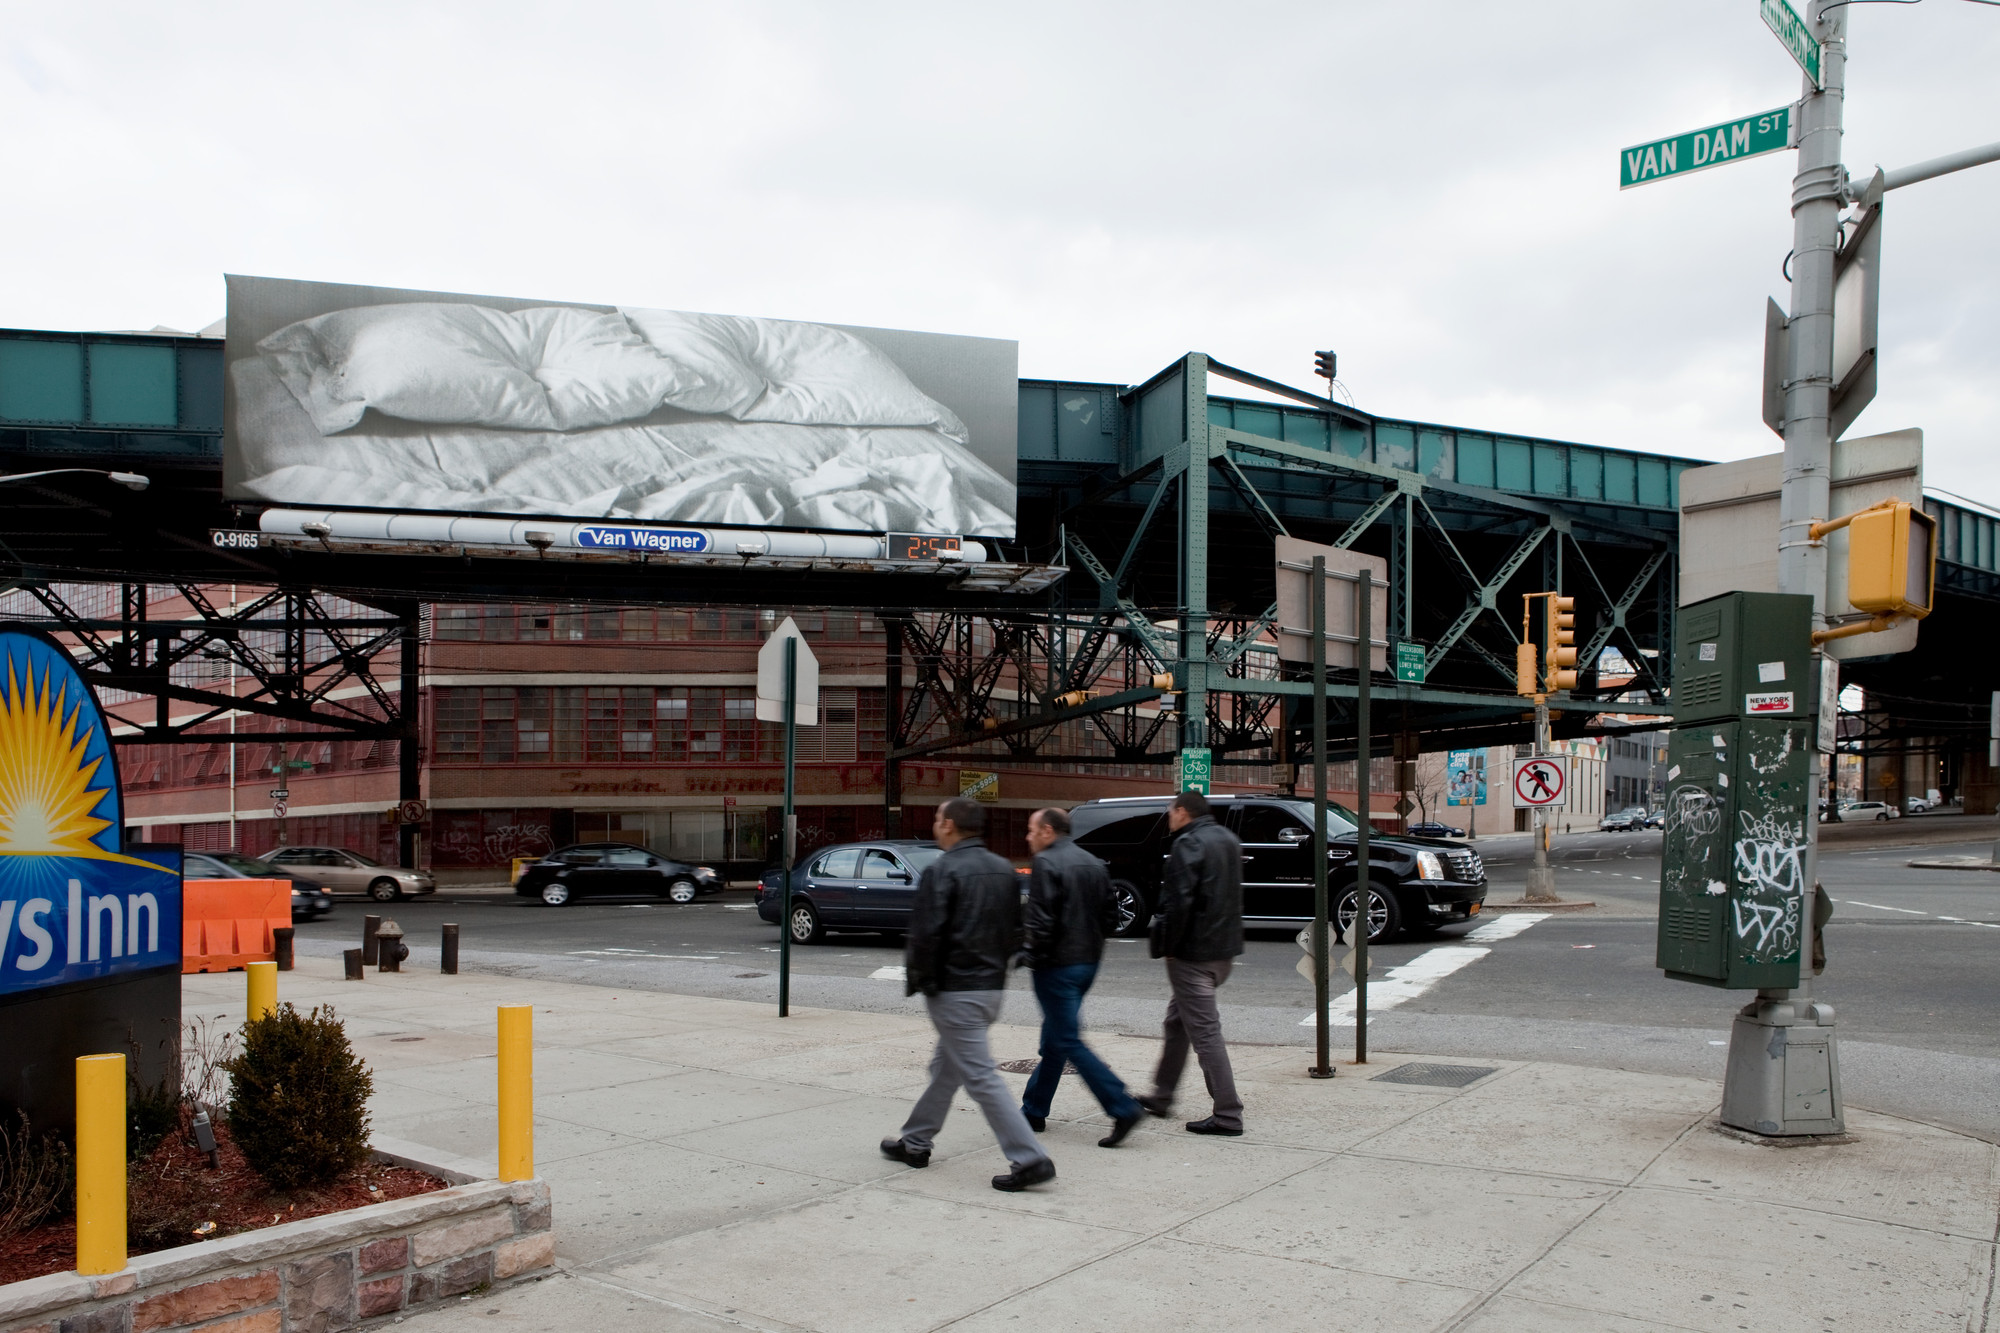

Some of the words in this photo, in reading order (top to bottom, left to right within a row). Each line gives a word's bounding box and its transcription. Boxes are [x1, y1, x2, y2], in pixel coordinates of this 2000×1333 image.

[1627, 140, 1677, 181] VAN
[1693, 121, 1751, 166] DAM
[1757, 113, 1783, 134] ST
[213, 531, 258, 548] Q-9165
[582, 529, 626, 546] Van
[631, 531, 700, 551] Wagner
[963, 773, 997, 798] 392-5959
[67, 878, 159, 965] Inn
